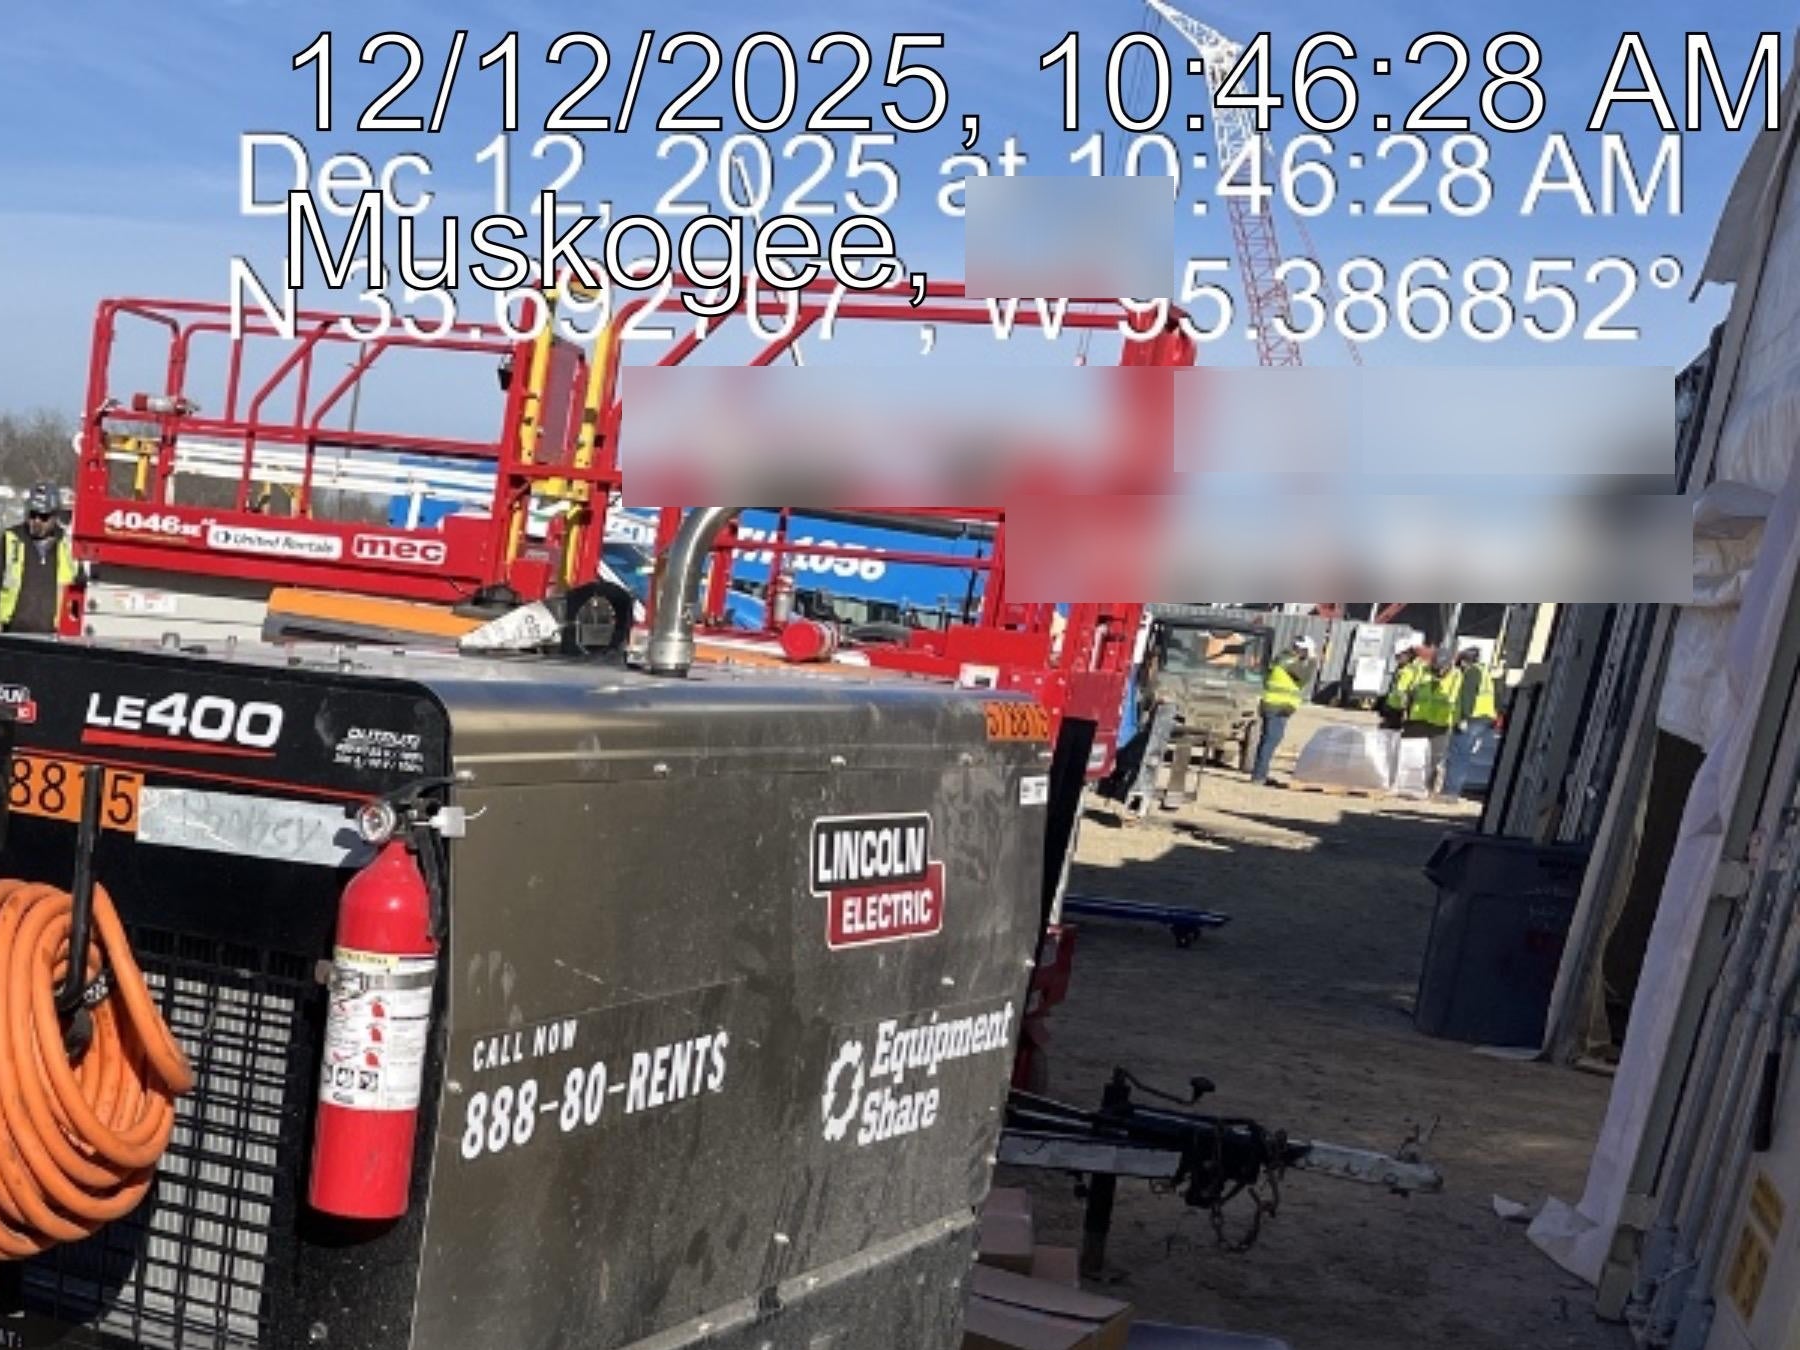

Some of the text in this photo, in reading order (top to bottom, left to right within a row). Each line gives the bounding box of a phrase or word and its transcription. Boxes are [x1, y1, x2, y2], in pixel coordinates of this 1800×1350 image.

[356, 536, 443, 562] mec
[85, 692, 284, 748] LE400
[8, 758, 135, 825] 885
[818, 827, 926, 882] LINCOLN
[842, 887, 934, 934] ELECTRIC
[473, 1019, 578, 1072] CALL NOW
[869, 1000, 1015, 1084] Equipment
[461, 1029, 729, 1159] 888-80-RENTS
[857, 1085, 940, 1146] Share
